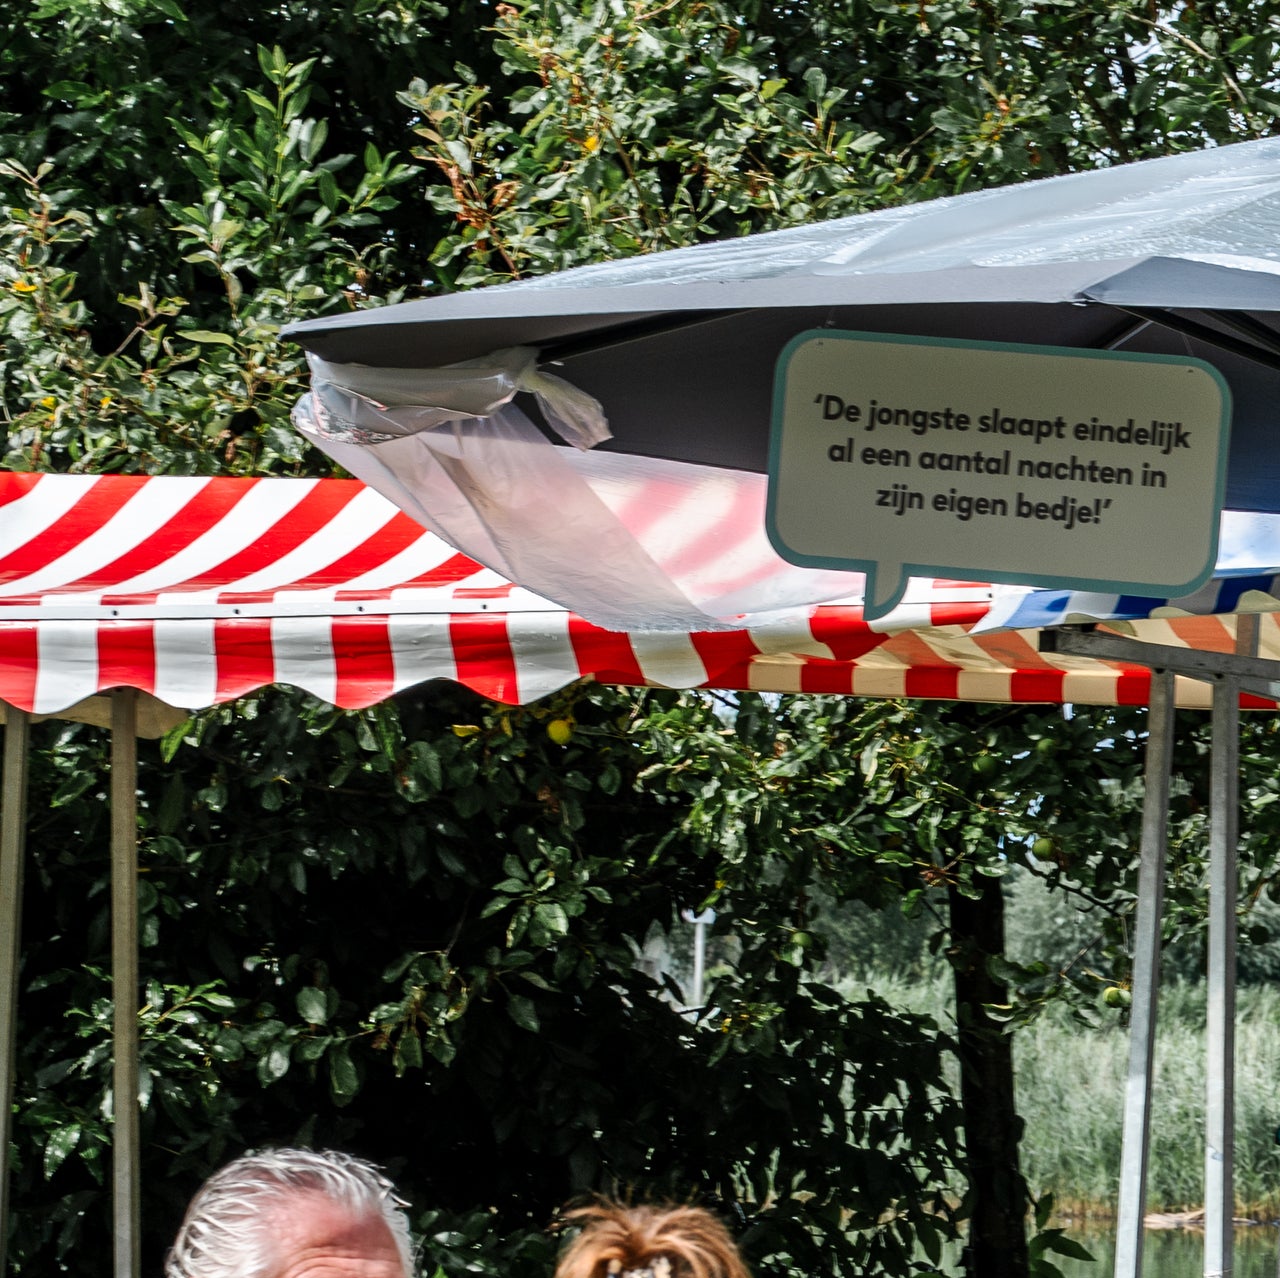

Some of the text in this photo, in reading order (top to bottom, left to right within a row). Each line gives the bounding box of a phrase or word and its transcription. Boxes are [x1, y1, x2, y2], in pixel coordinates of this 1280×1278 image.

[865, 401, 970, 434] jongste
[977, 408, 1066, 443] slaapt
[1073, 417, 1191, 454] eindelijk
[828, 438, 1167, 488] al een aantal nachten in
[876, 484, 924, 514] zijn
[931, 489, 1007, 522] eigen
